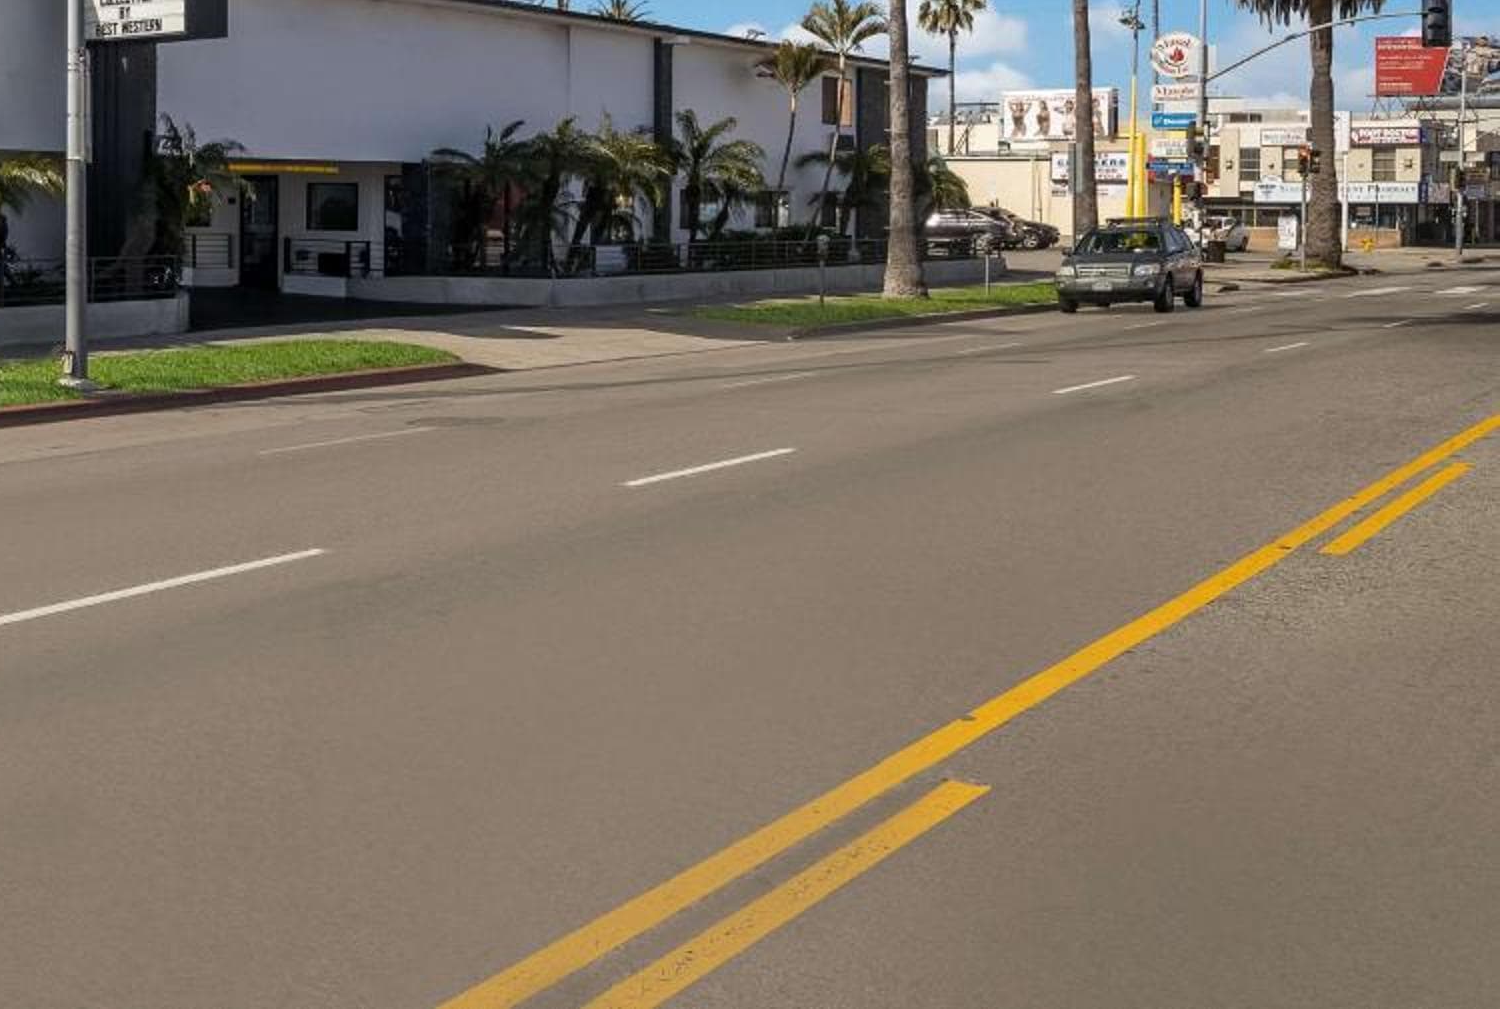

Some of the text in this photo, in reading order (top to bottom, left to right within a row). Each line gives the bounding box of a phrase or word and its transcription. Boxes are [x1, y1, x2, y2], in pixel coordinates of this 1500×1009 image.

[119, 7, 131, 20] BY
[96, 19, 163, 37] BEST WESTERN
